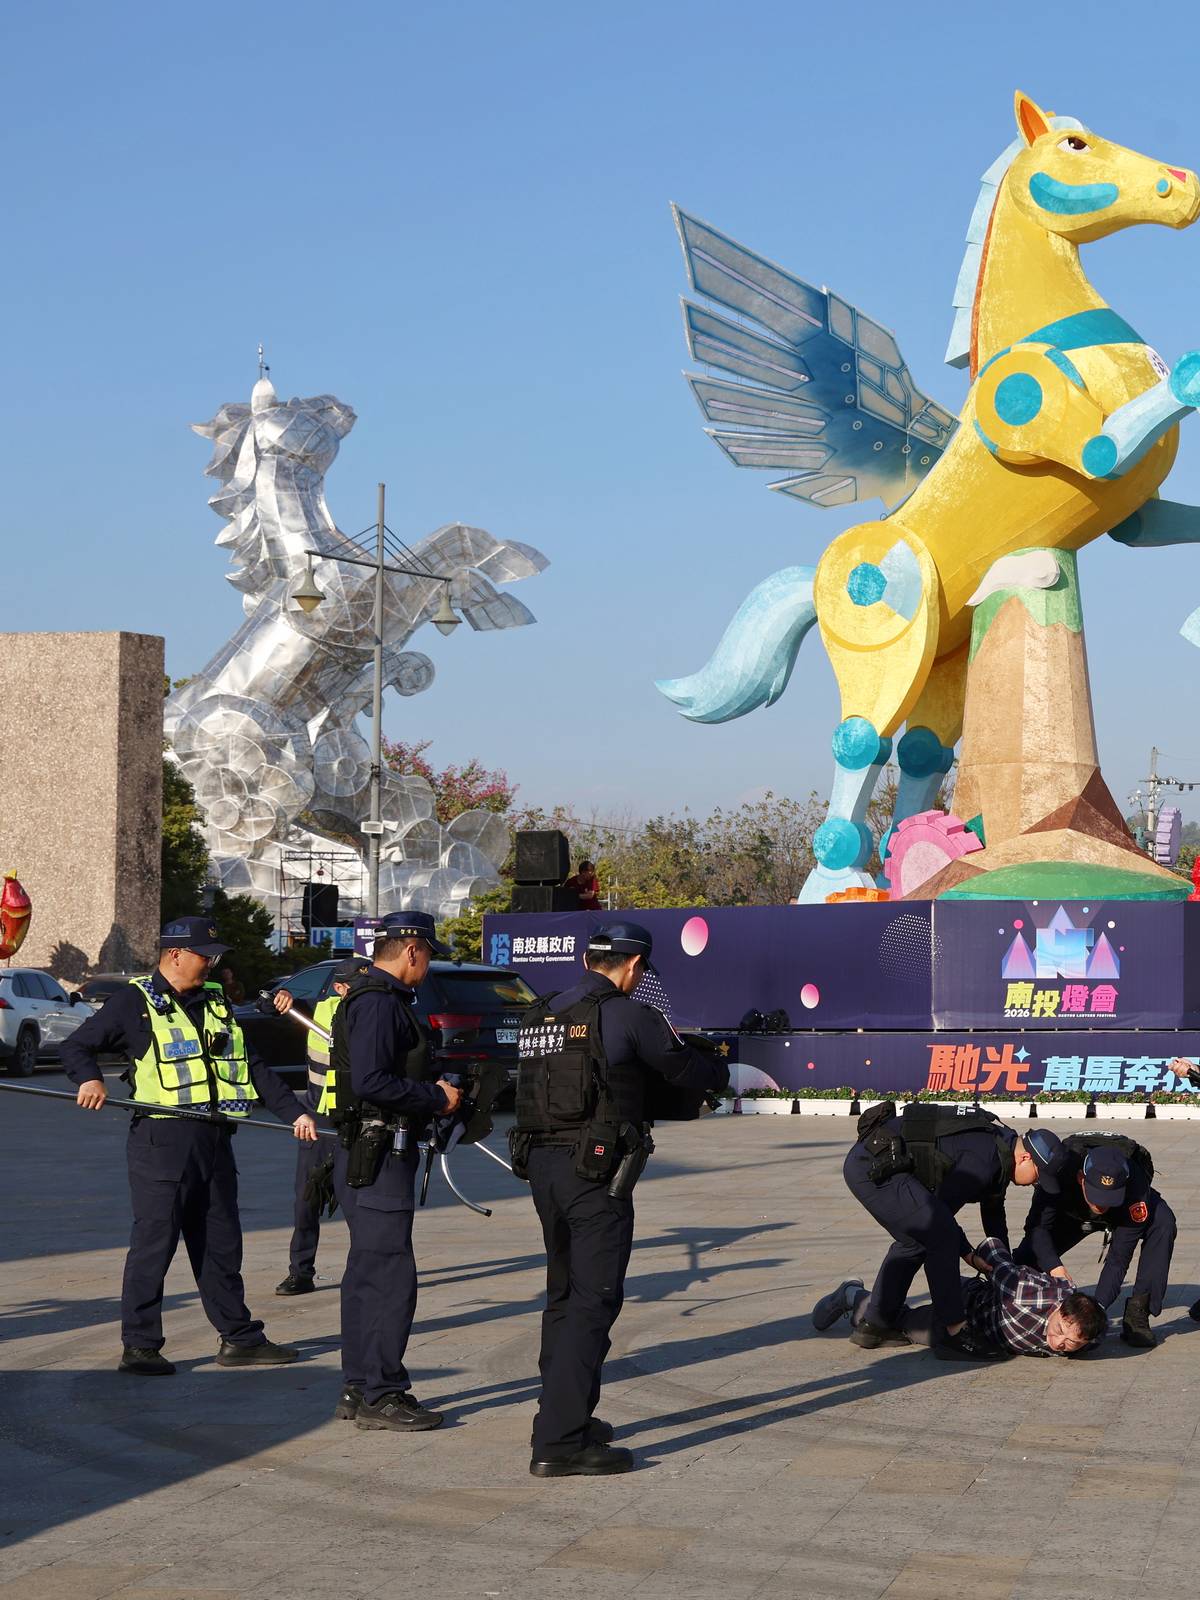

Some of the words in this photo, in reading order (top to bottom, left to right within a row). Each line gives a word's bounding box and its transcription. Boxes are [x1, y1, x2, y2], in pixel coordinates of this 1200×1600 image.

[513, 936, 575, 954] 南投縣政府
[1004, 982, 1119, 1018] 南投燈會
[1004, 1009, 1030, 1017] 2026
[569, 1025, 587, 1038] 002
[926, 1044, 1030, 1092] 馳光
